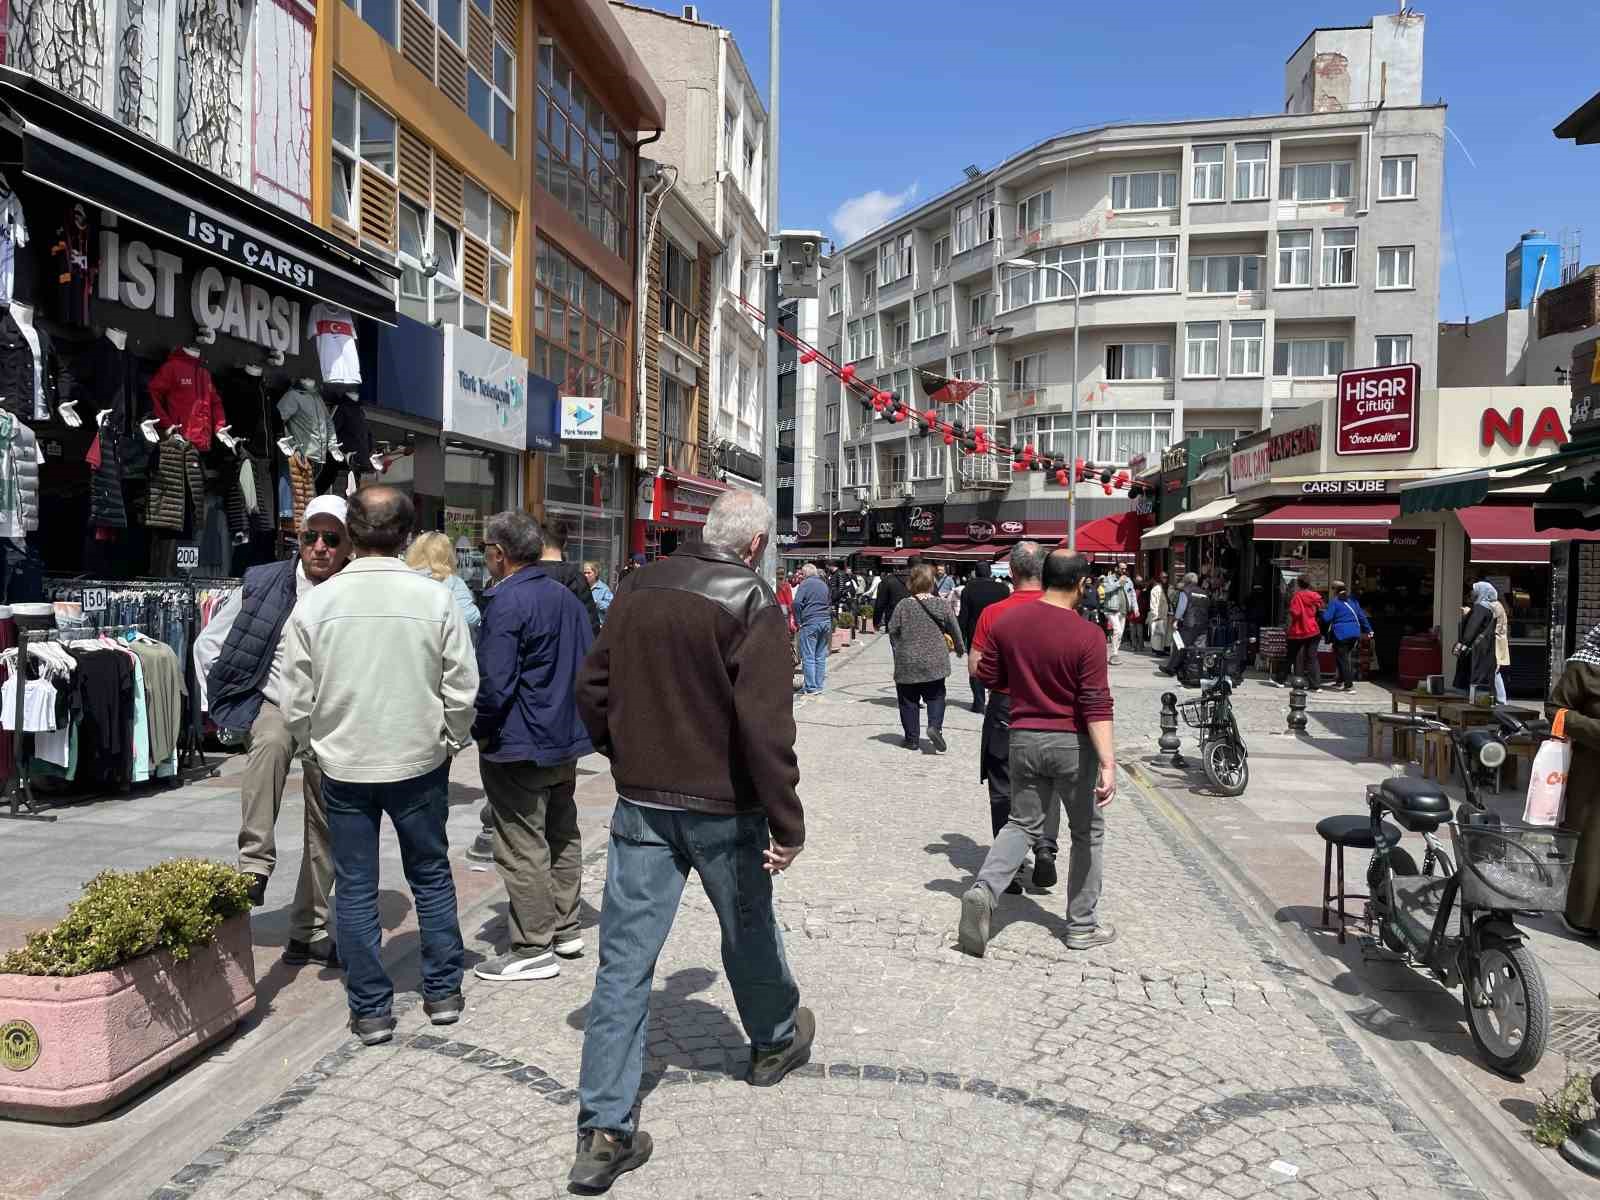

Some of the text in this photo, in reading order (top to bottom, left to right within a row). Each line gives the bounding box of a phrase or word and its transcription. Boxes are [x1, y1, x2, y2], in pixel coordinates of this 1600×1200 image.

[188, 211, 315, 287] İST ÇARŞI
[98, 211, 301, 367] İST ÇARŞI
[458, 370, 477, 394] Türk
[1346, 377, 1406, 400] HİSAR
[1356, 398, 1395, 415] Çiftliği
[1301, 527, 1337, 537] NAMSAN
[177, 550, 195, 564] 200
[83, 590, 103, 607] 150
